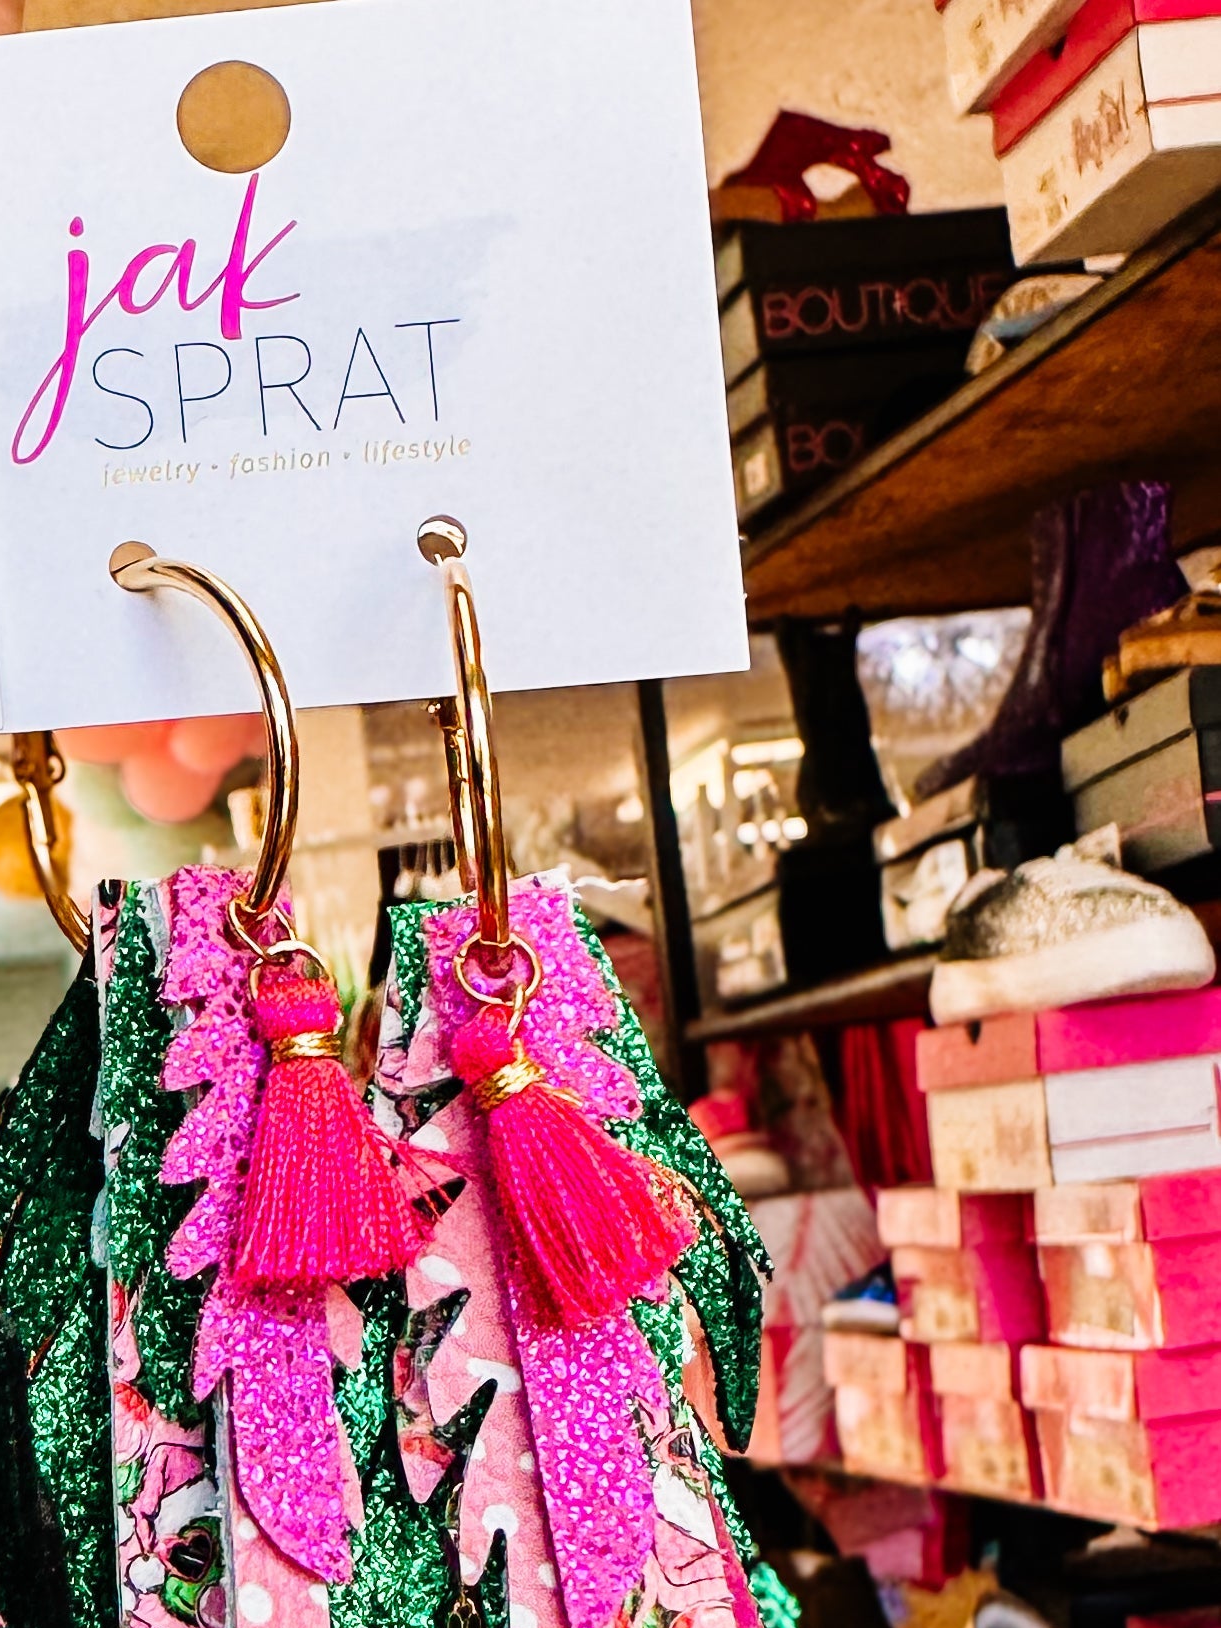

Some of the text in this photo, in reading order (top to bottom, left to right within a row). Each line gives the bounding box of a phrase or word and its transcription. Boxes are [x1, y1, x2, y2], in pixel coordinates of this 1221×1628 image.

[12, 173, 300, 465] jak
[93, 319, 461, 450] SPRAT
[103, 434, 473, 489] jewelry fashion lifestyle
